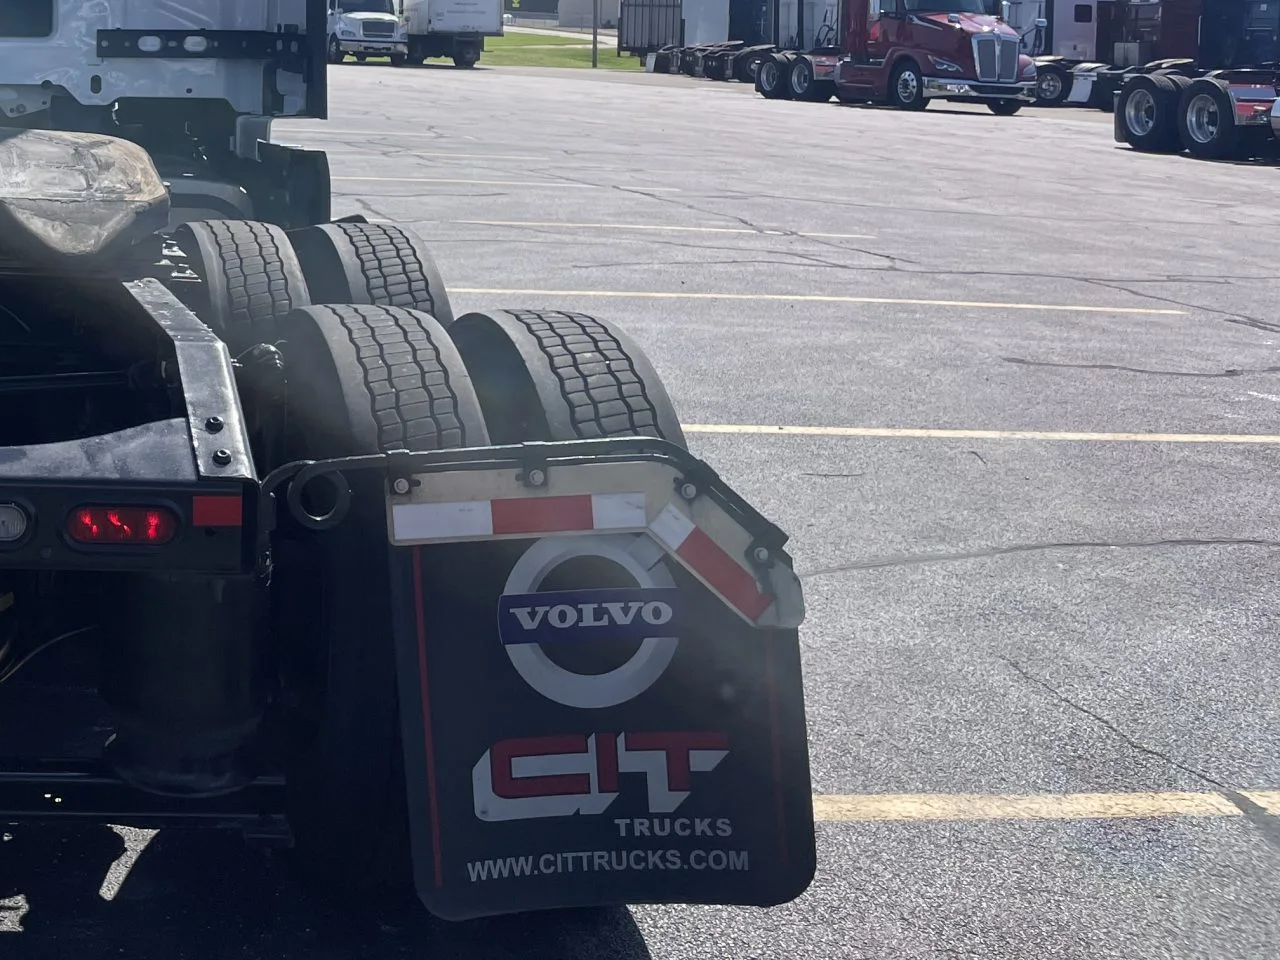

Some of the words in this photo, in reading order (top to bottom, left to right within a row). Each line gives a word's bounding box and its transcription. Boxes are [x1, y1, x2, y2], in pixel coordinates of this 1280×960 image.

[509, 599, 673, 631] VOLVO
[471, 731, 730, 822] CIT
[613, 817, 733, 837] TRUCKS
[466, 849, 749, 882] WWW.CITTRUCKS.COM
